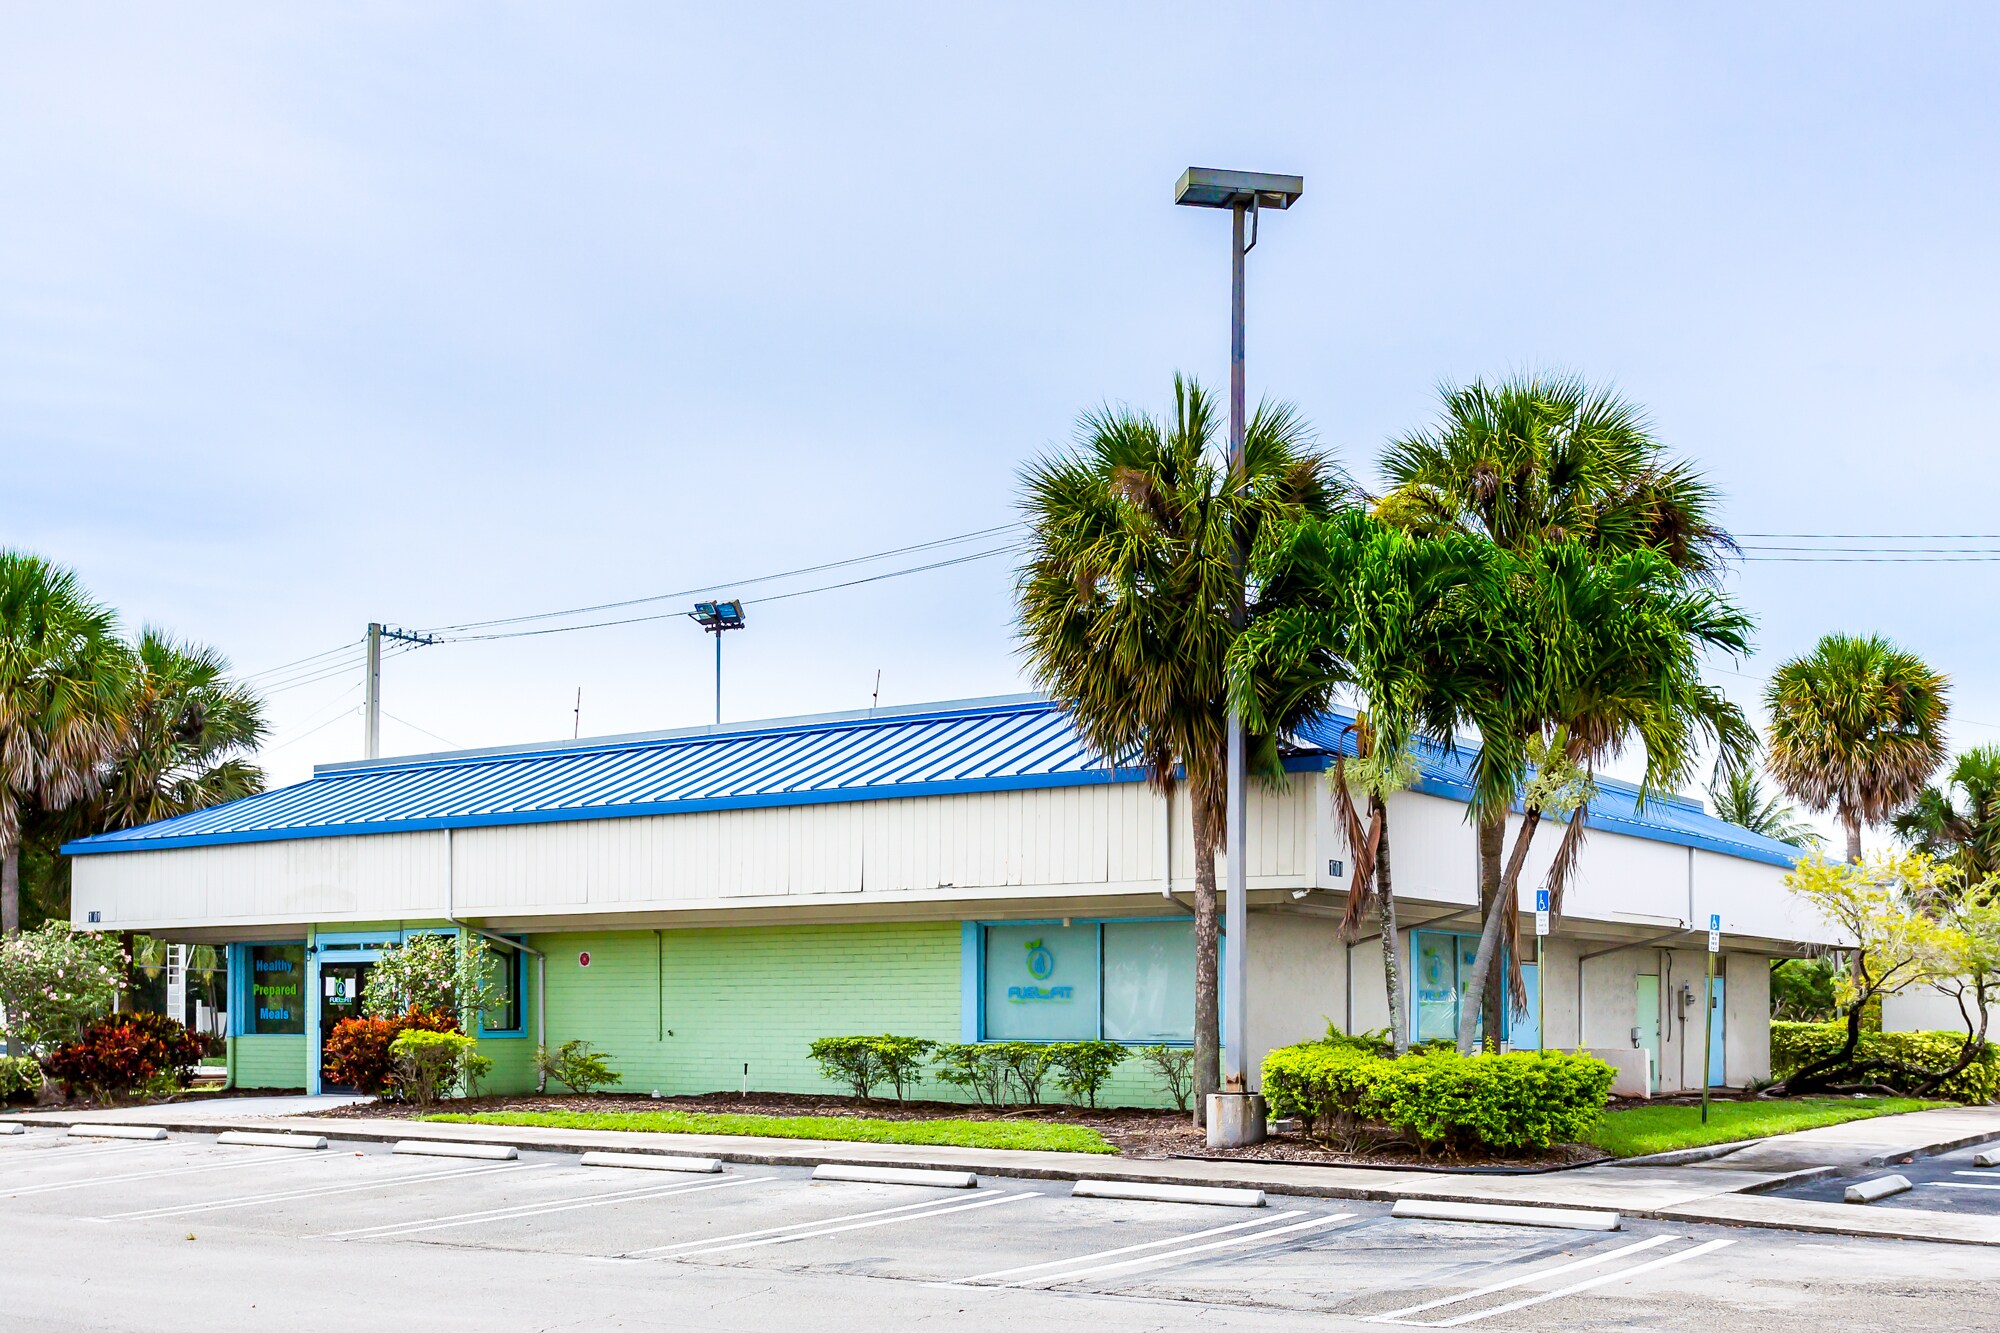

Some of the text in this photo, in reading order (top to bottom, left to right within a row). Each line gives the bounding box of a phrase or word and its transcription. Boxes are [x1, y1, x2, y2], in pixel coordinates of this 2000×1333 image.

[256, 960, 292, 974] Healthy
[253, 984, 297, 997] Prepared
[260, 1008, 289, 1020] Meals
